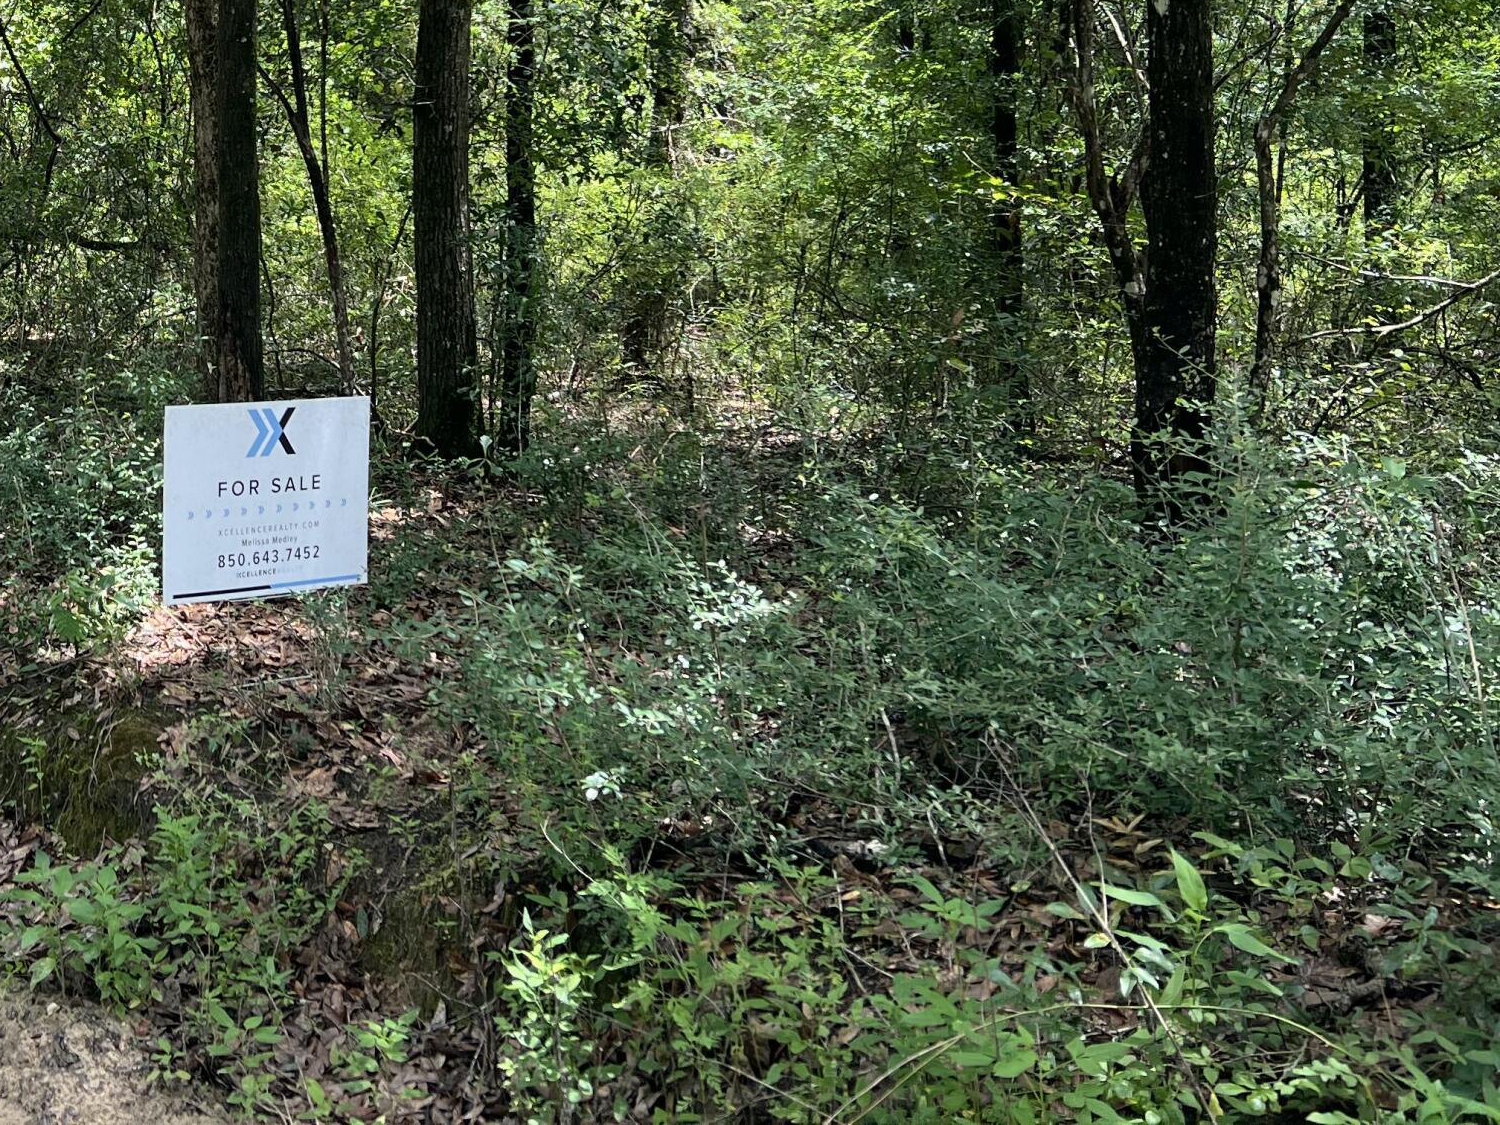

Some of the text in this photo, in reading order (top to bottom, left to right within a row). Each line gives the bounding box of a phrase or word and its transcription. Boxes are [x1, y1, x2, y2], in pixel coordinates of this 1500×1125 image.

[218, 474, 321, 498] FOR SALE
[218, 520, 320, 536] XCELLENCEREALTY.COM
[241, 535, 298, 547] Melissa Medley
[218, 545, 321, 569] 850.643.7452
